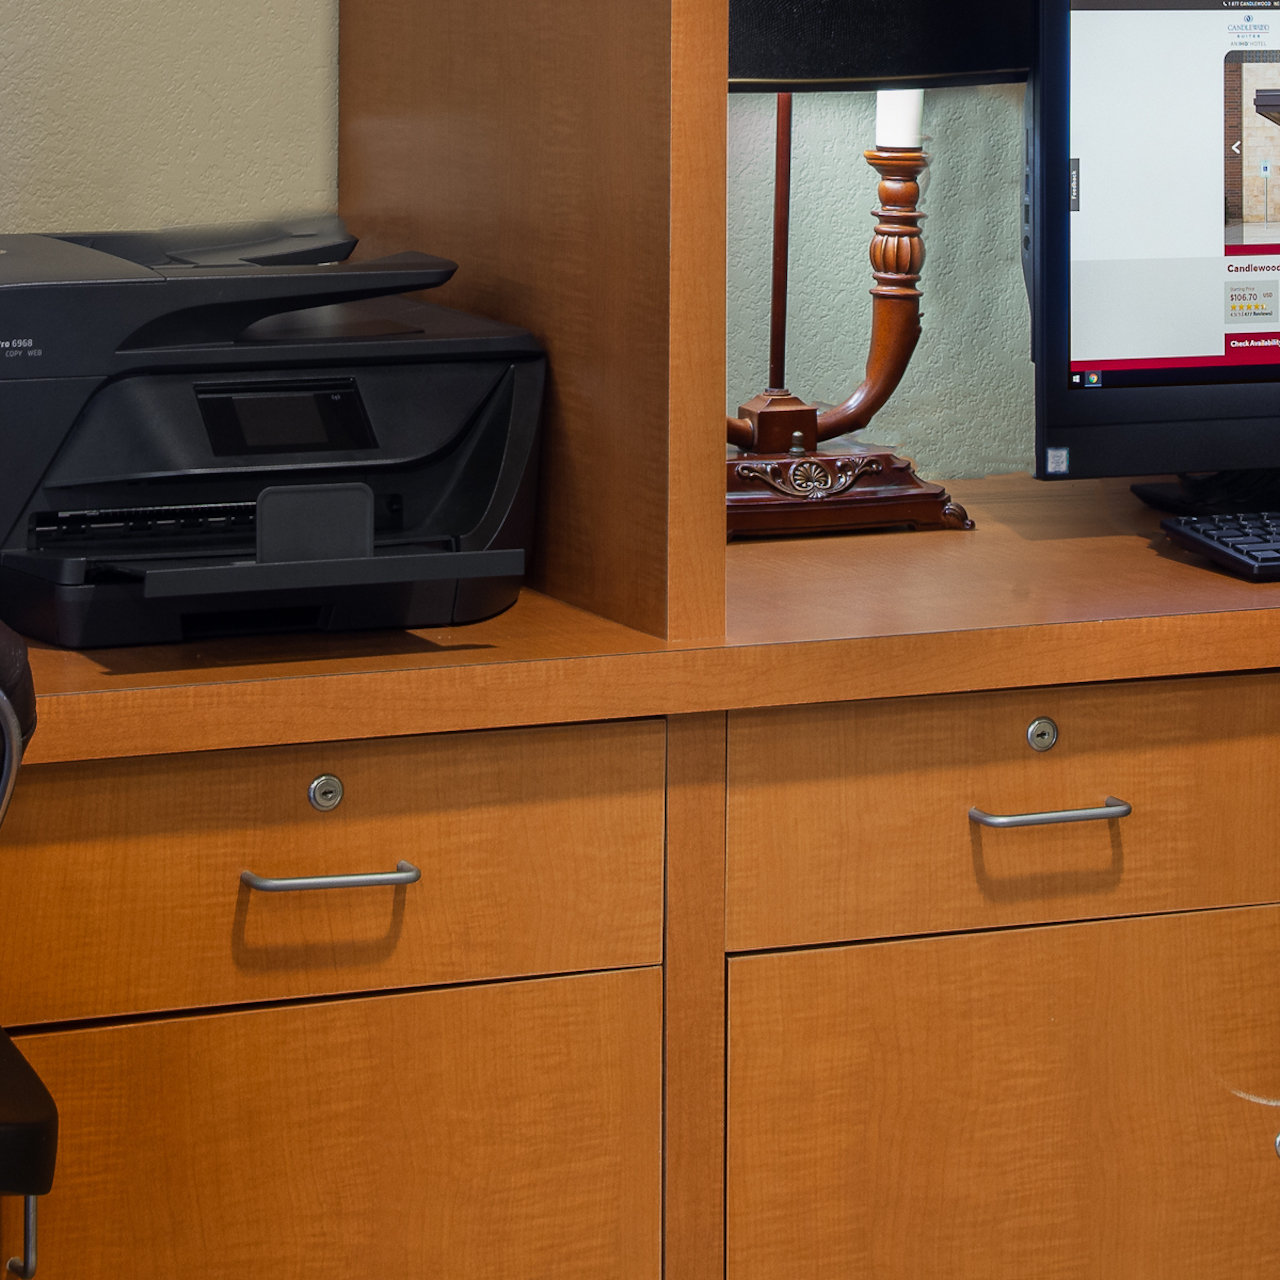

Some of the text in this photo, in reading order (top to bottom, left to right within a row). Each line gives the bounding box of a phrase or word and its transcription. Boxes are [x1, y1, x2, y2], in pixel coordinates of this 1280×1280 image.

[1230, 293, 1258, 301] $106.70
[11, 338, 33, 347] 6968
[1230, 340, 1249, 348] Check
[5, 350, 23, 358] COPY
